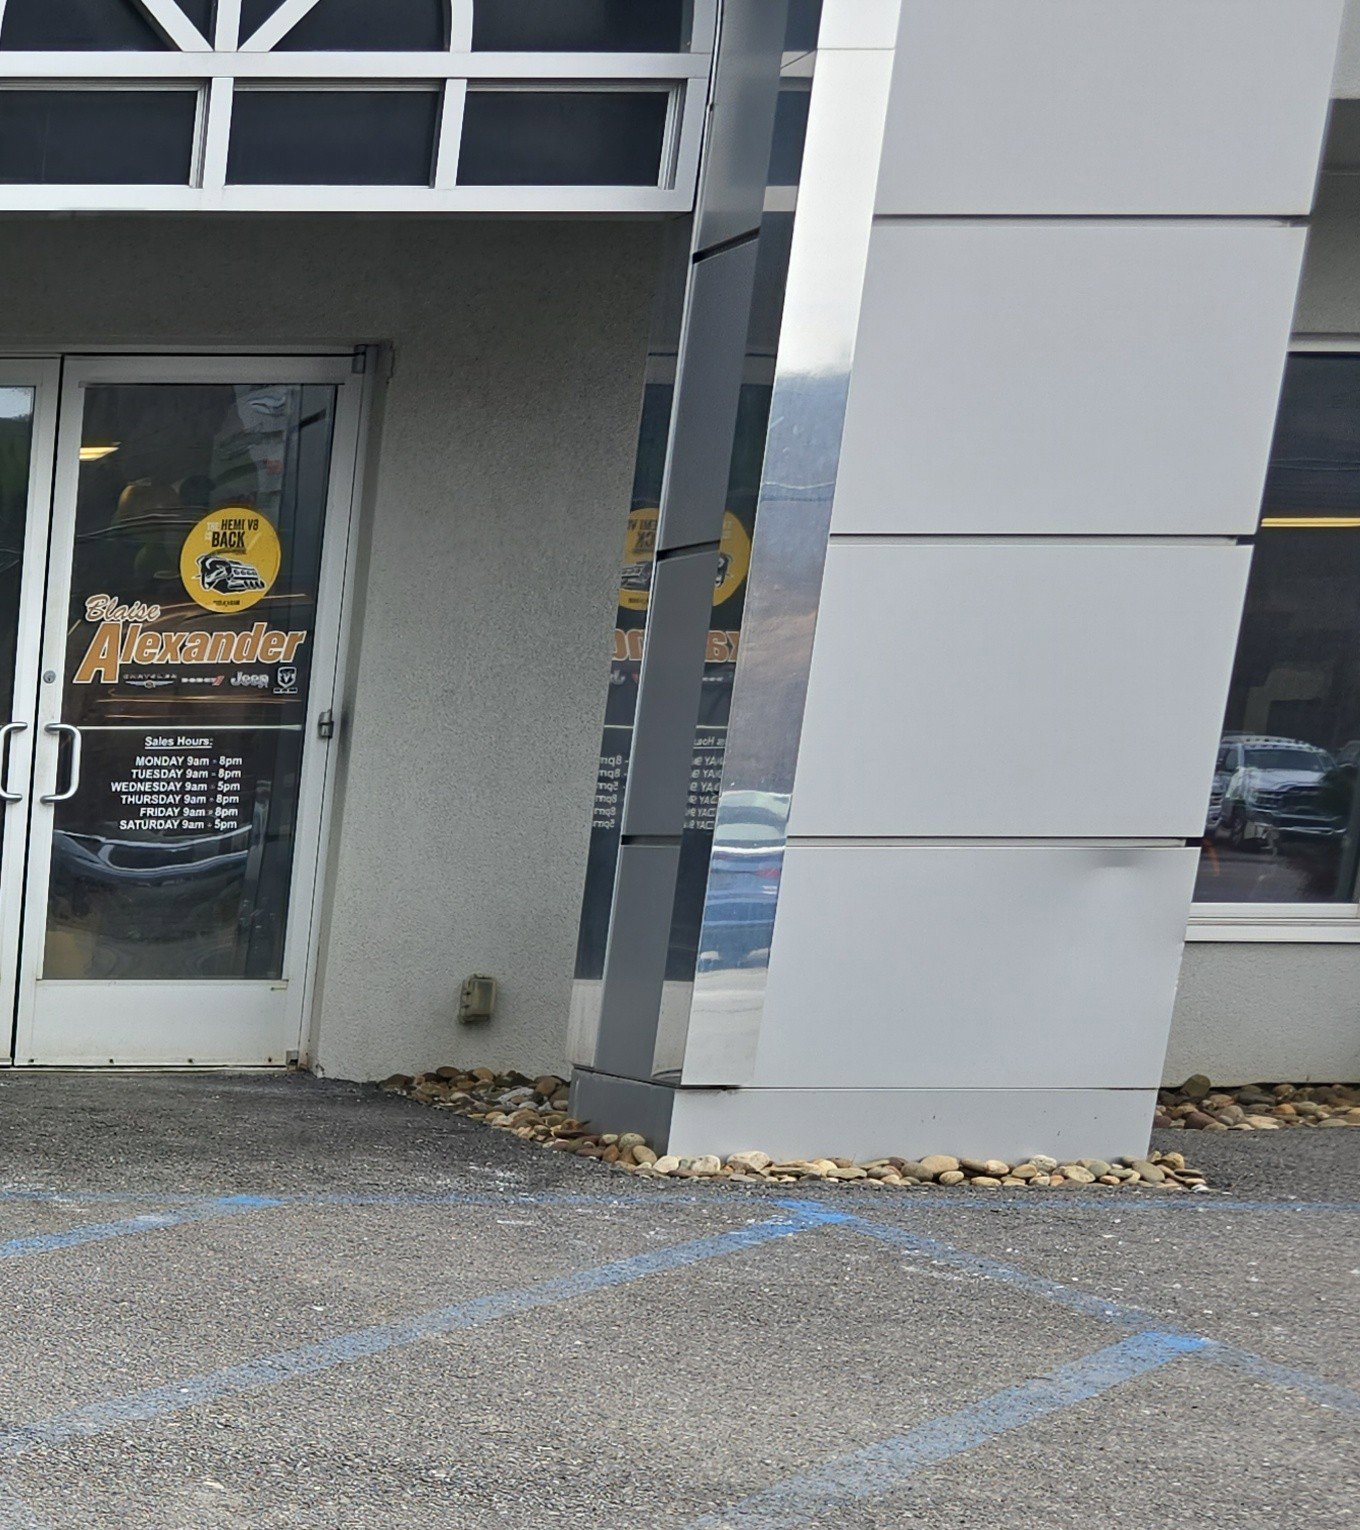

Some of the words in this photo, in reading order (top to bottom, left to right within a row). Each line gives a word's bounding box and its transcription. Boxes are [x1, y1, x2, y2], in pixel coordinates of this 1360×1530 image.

[221, 519, 246, 531] HEMI
[248, 518, 259, 531] V8
[211, 531, 246, 547] BACK
[85, 593, 161, 622] Blaise
[72, 620, 307, 684] Alexander
[230, 671, 269, 688] Jeep
[145, 736, 174, 747] Sales
[177, 736, 213, 746] Hours:
[135, 756, 184, 766] MONDAY
[187, 756, 209, 766] 9am
[219, 756, 242, 767] 8pm
[131, 769, 183, 779] TUESDAY
[186, 769, 208, 778] 9am
[218, 769, 241, 780] 8pm
[111, 782, 182, 792] WEDNESDAY
[185, 782, 207, 791] 9am
[217, 782, 240, 793] 5pm
[121, 795, 181, 805] THURSDAY
[184, 795, 206, 804] 9am
[216, 794, 239, 805] 8pm
[139, 807, 180, 817] FRIDAY
[183, 807, 205, 817] 9am
[215, 807, 238, 818] 8pm
[119, 820, 179, 830] SATURDAY
[182, 820, 204, 829] 9am
[214, 819, 237, 830] 5pm
